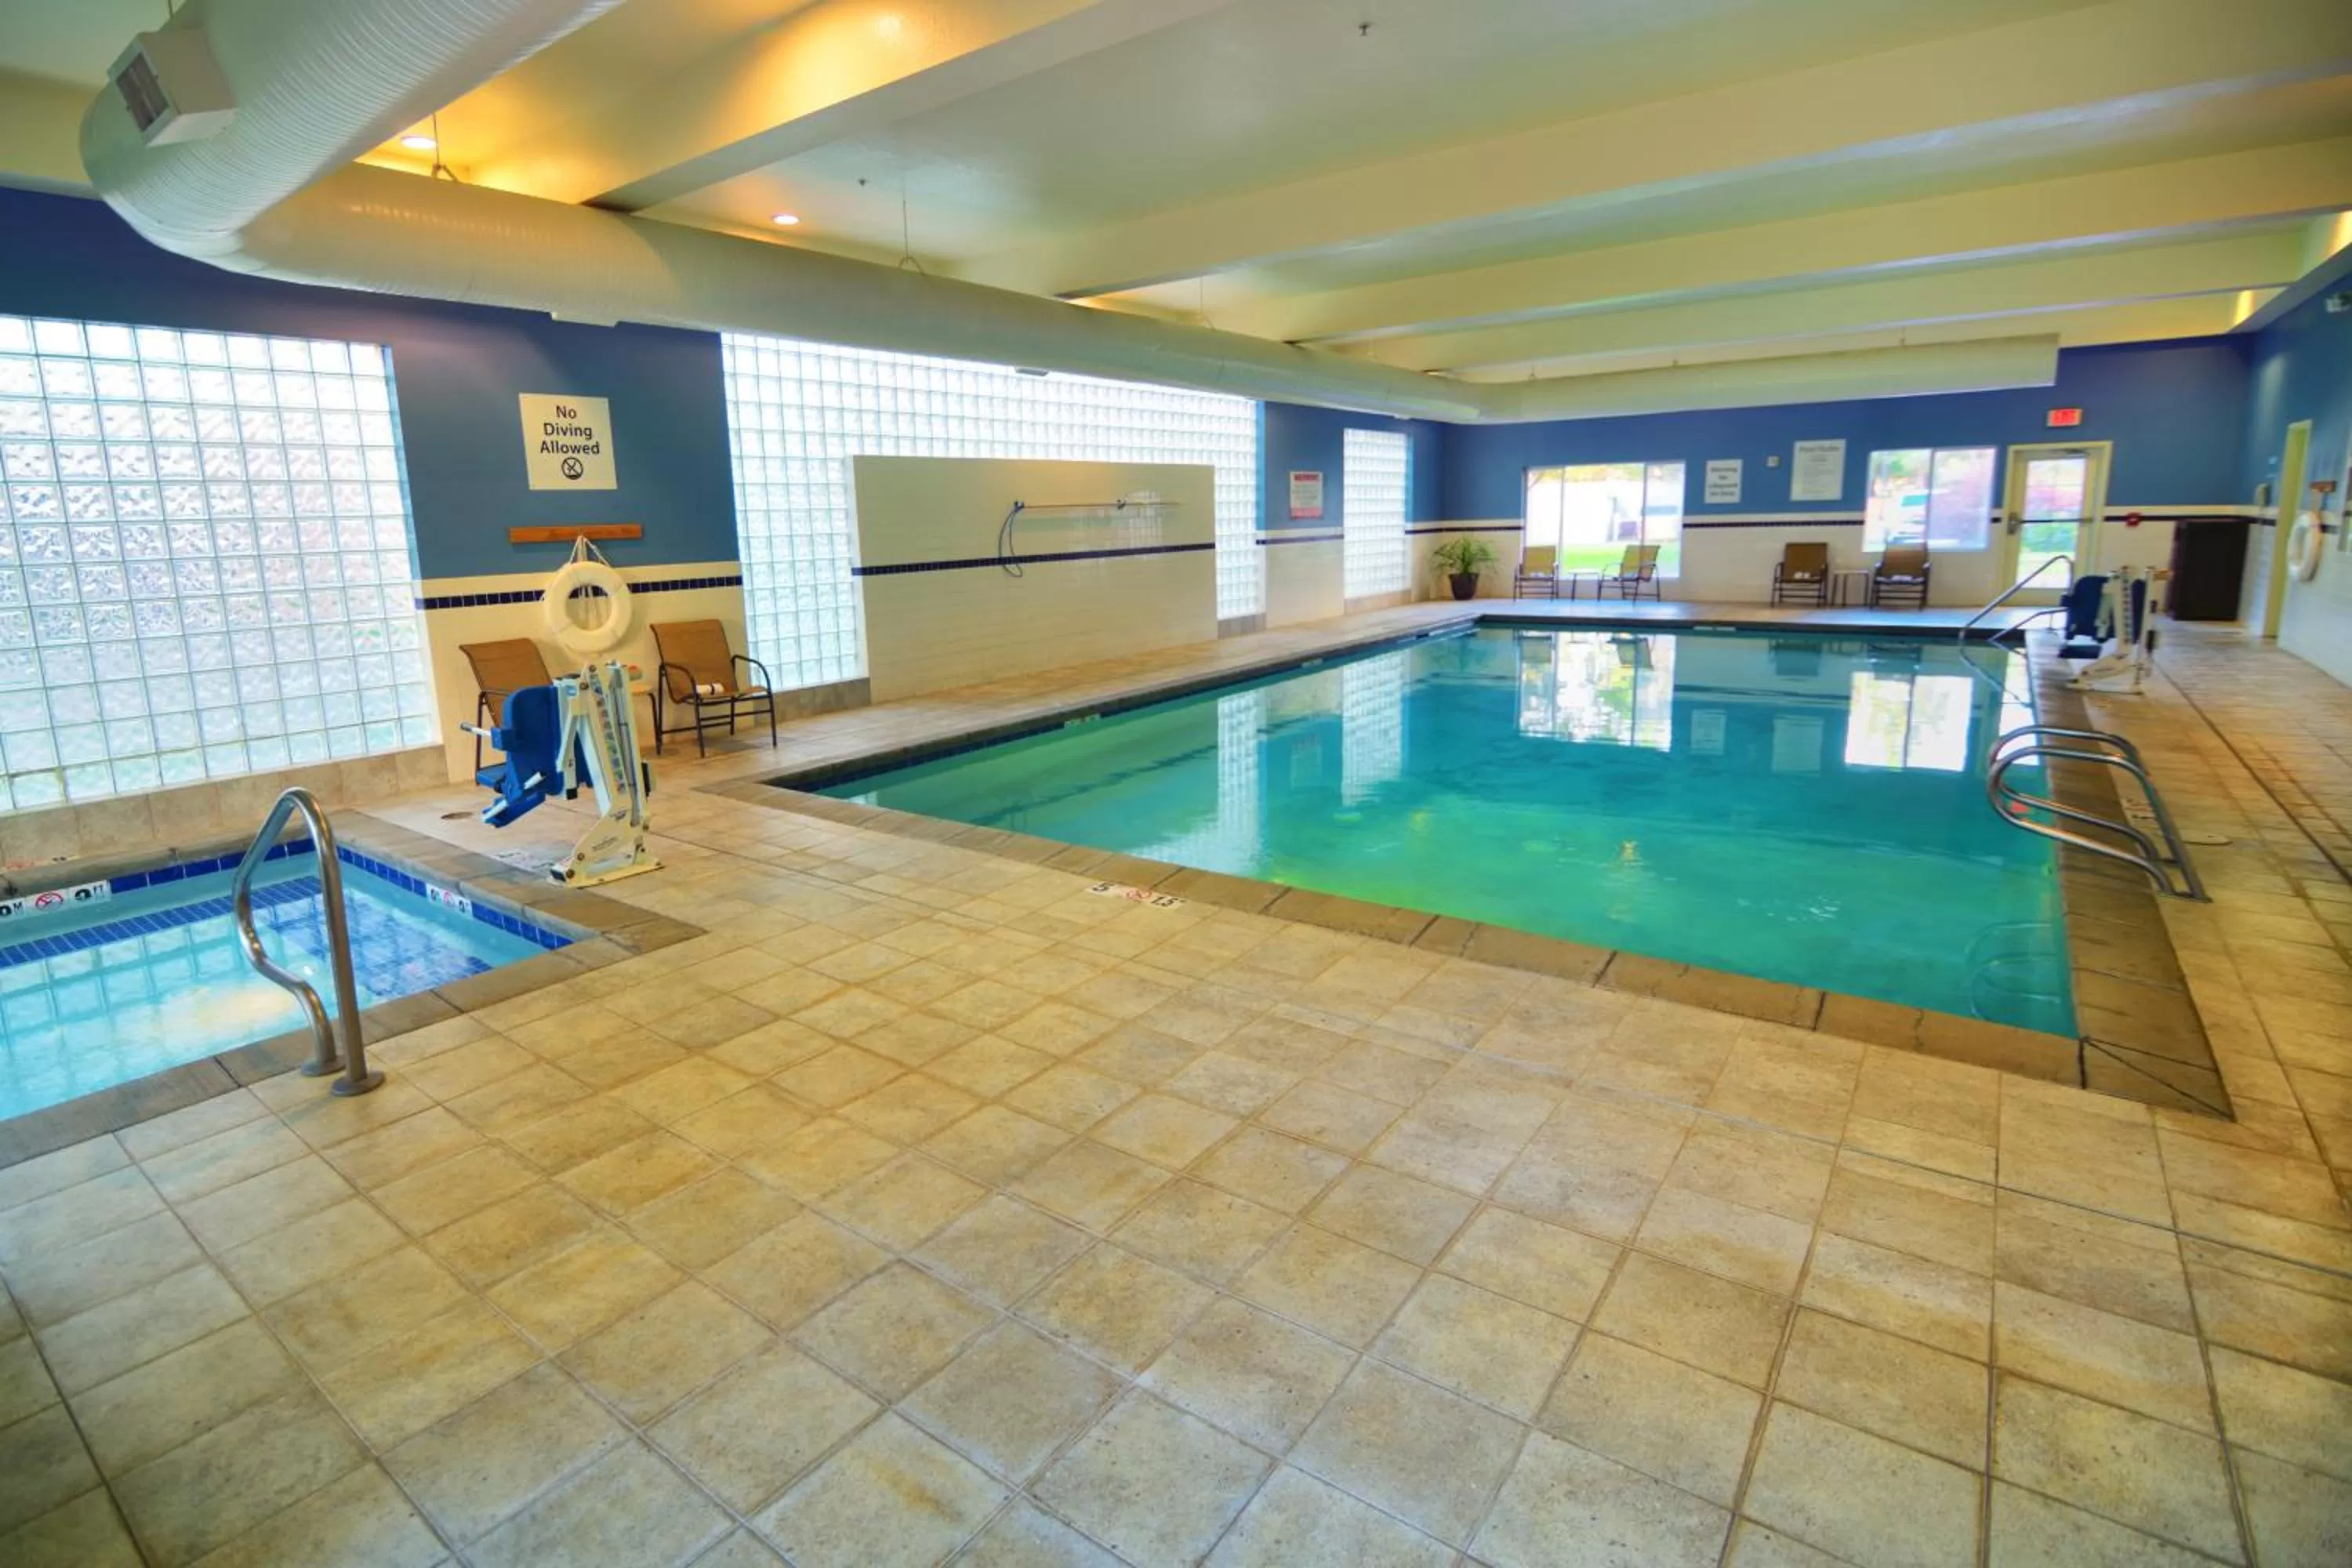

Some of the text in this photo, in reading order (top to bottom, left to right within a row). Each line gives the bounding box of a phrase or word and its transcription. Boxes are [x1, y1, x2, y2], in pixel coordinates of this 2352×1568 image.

[556, 405, 577, 419] No
[543, 423, 593, 441] Diving
[540, 440, 600, 454] Allowed
